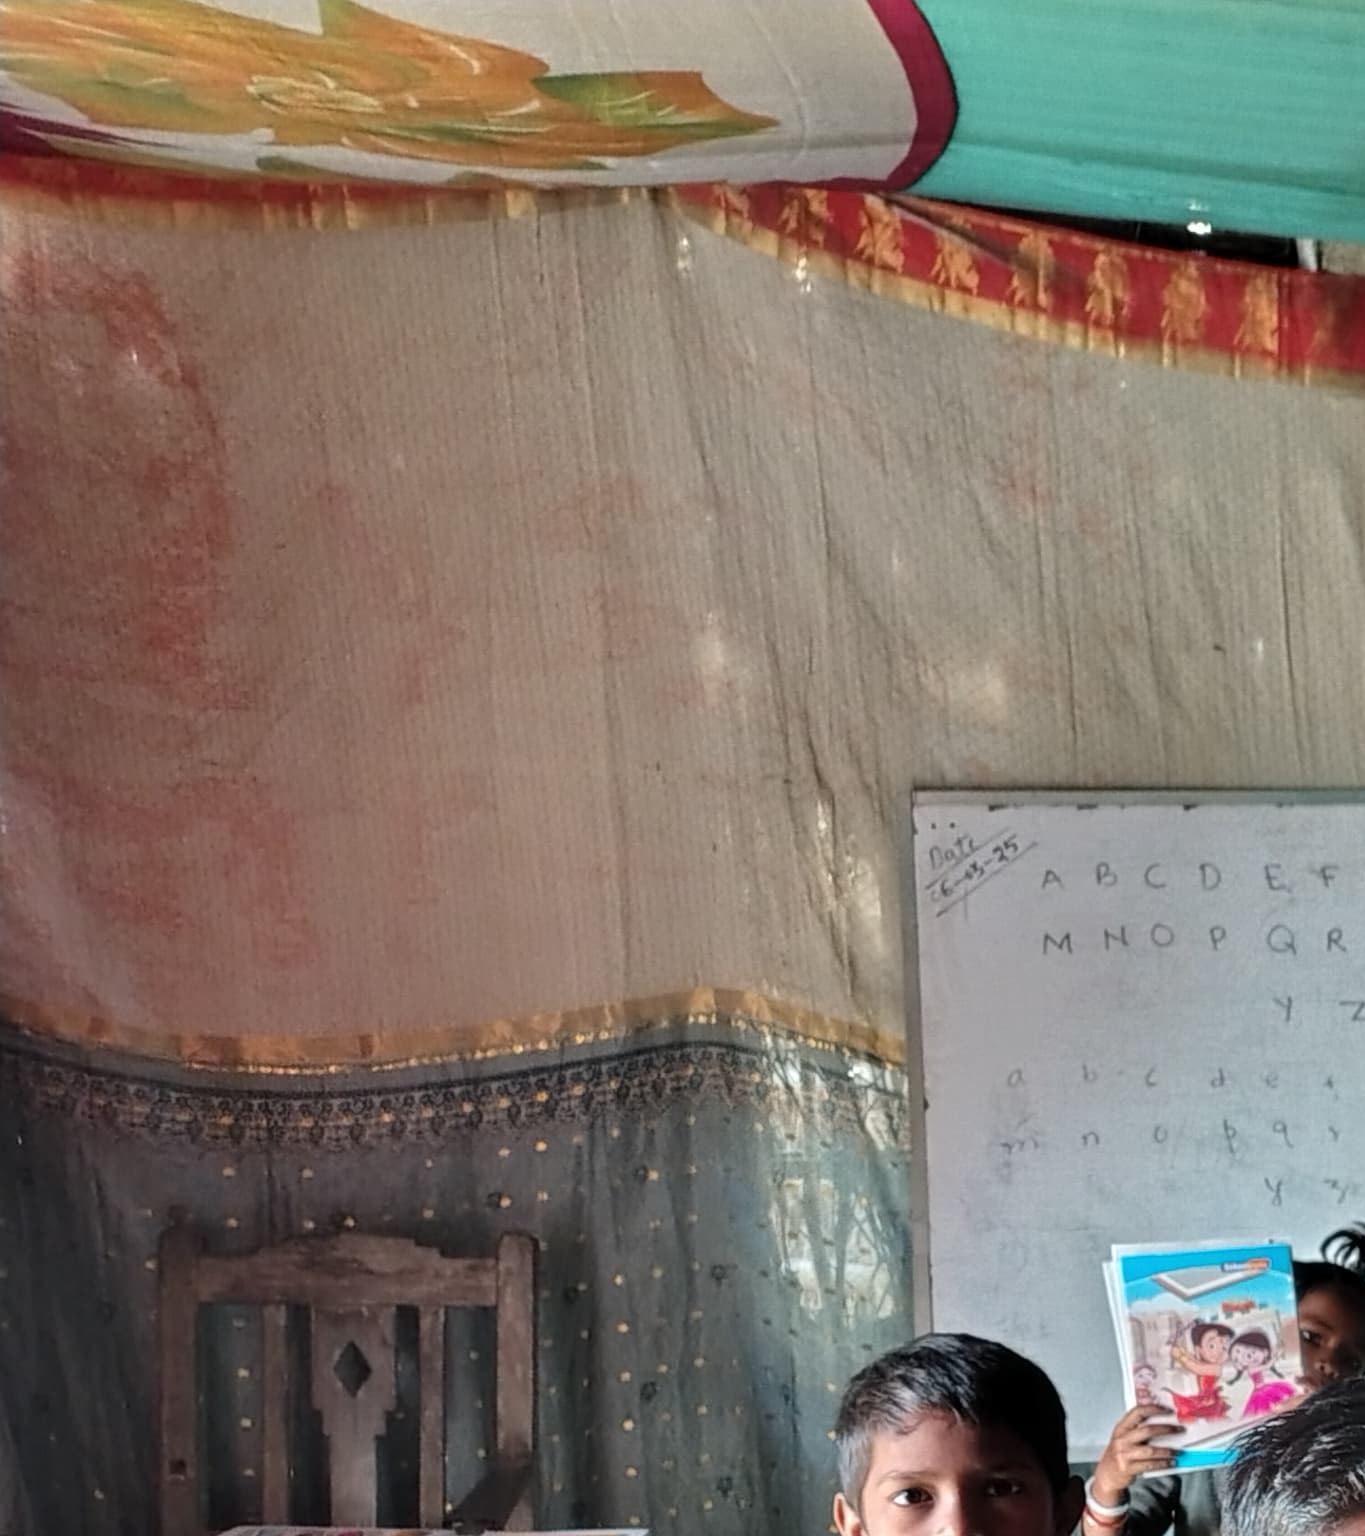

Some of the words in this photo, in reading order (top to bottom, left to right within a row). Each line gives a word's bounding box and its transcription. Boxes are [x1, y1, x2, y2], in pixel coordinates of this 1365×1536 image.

[1041, 869, 1064, 890] A
[1095, 861, 1118, 886] B
[1143, 862, 1167, 890] C
[1198, 862, 1222, 890] D
[1263, 864, 1286, 892] E
[1313, 864, 1338, 889] F
[1042, 932, 1073, 954] M
[1103, 925, 1130, 950] N
[1150, 922, 1176, 948] O
[1208, 925, 1227, 952] P
[1266, 924, 1298, 956] Q
[1326, 927, 1347, 953] R
[1273, 996, 1293, 1023] Y
